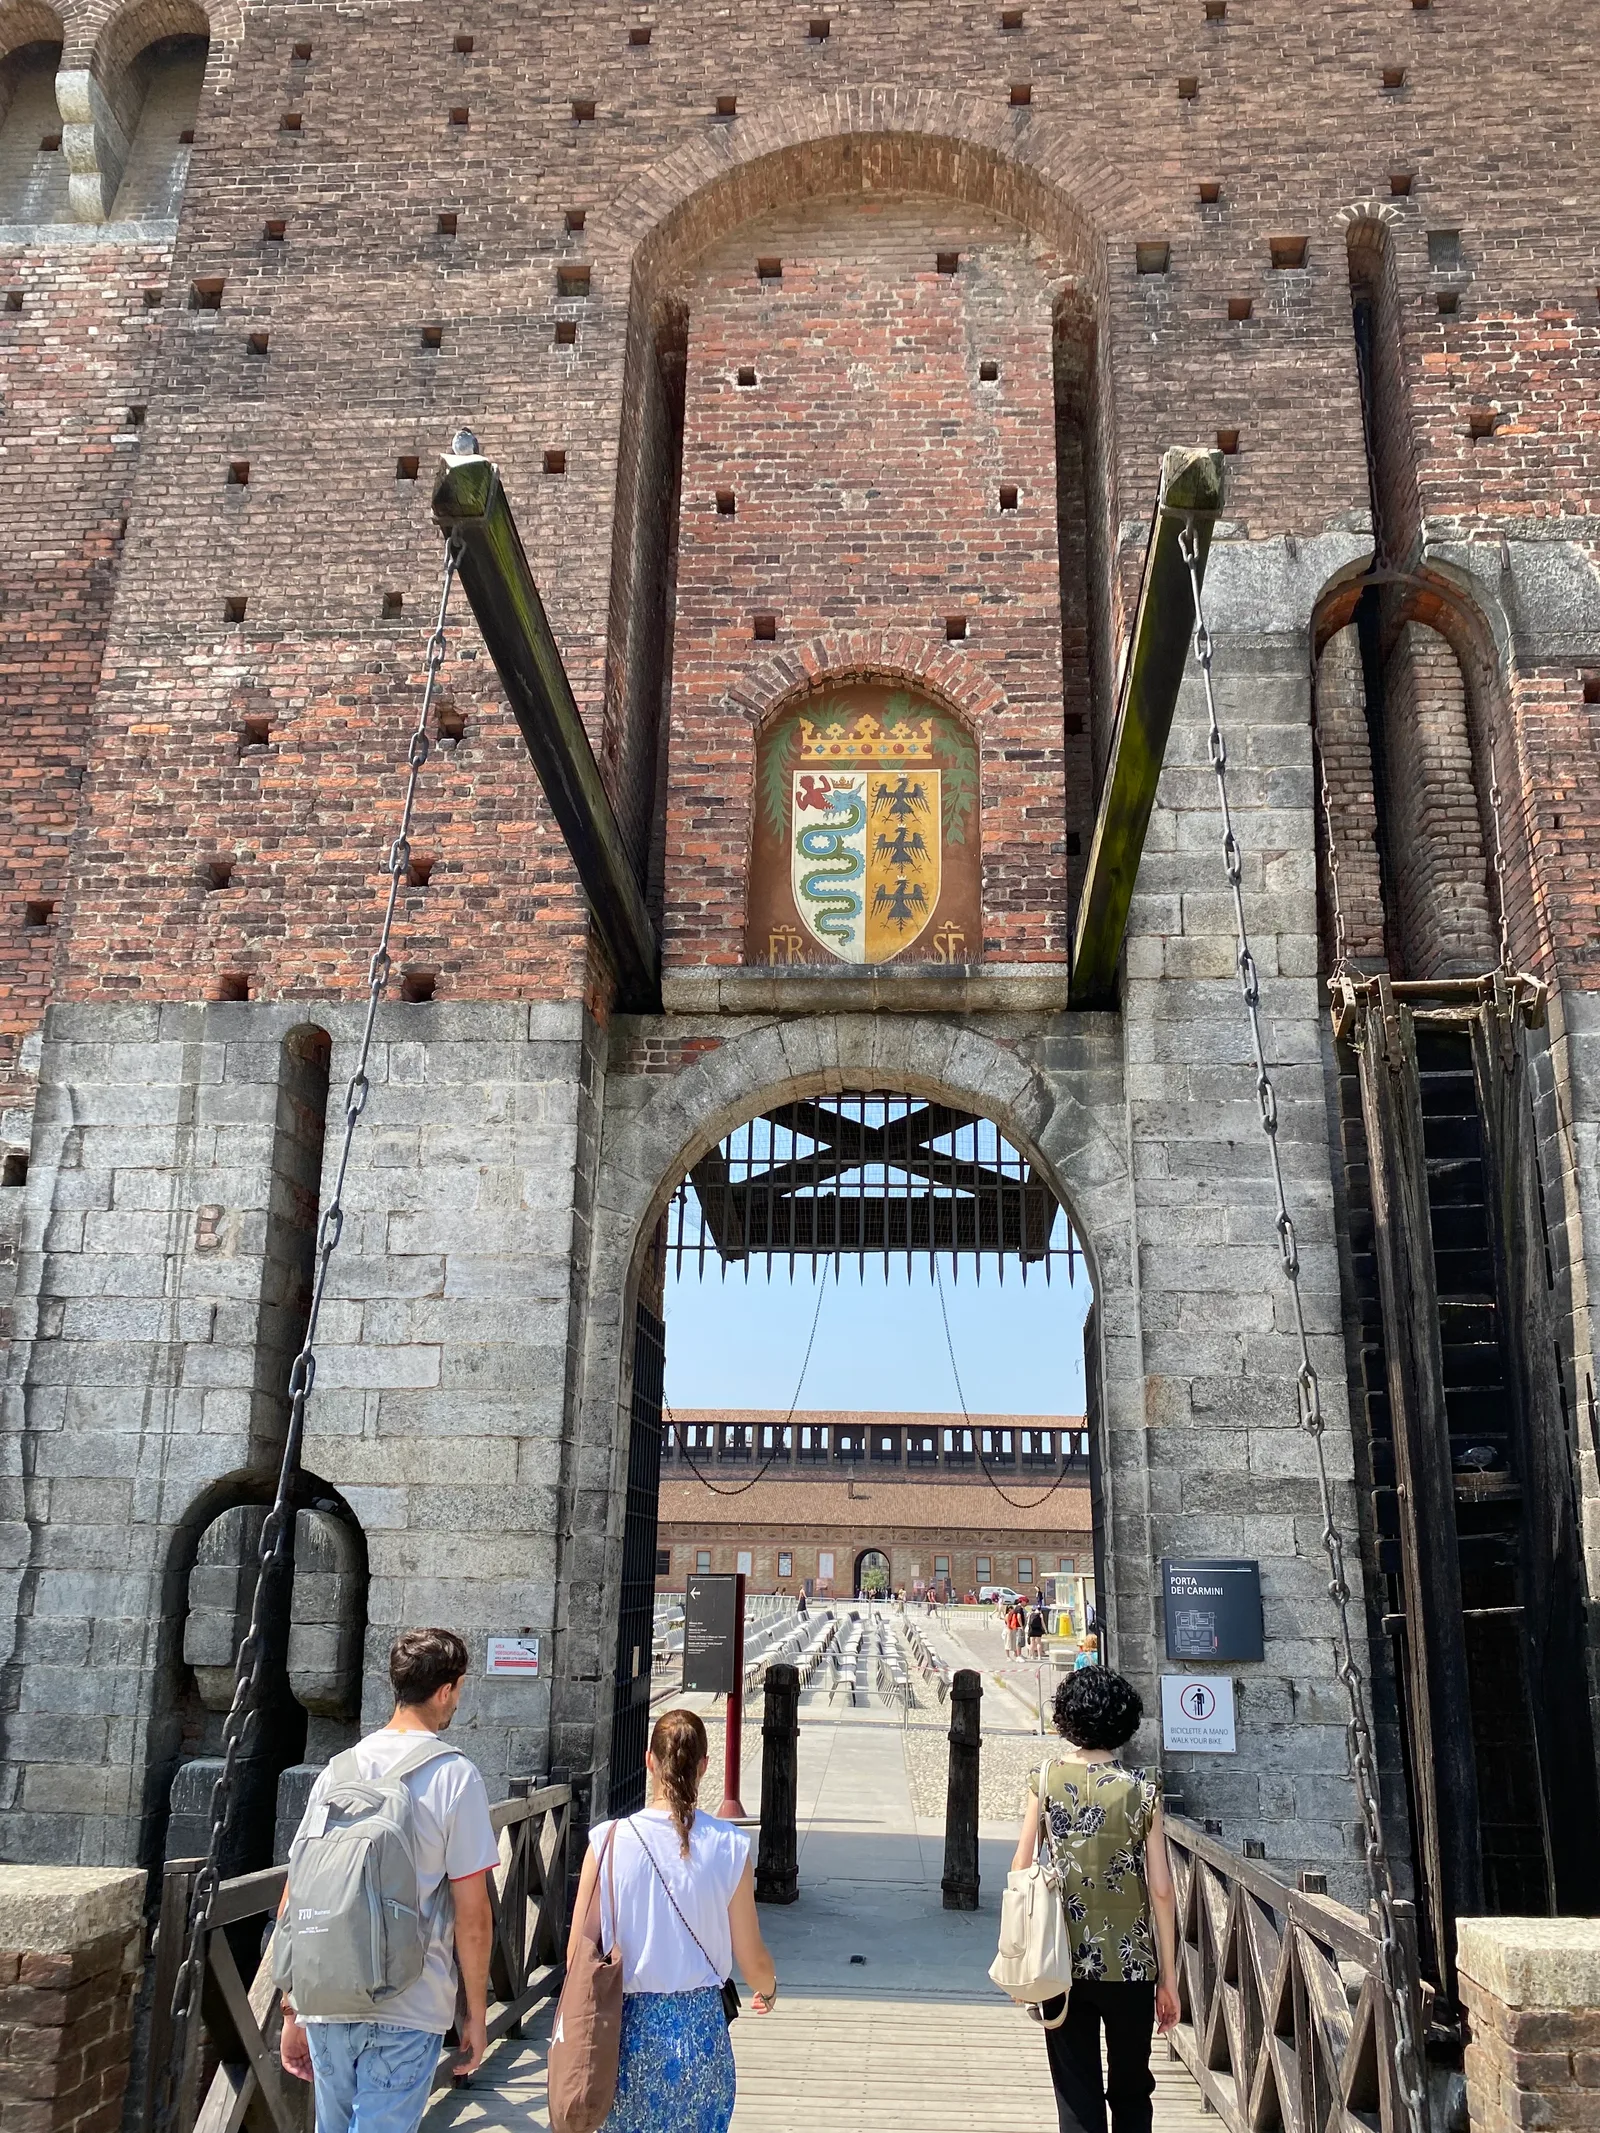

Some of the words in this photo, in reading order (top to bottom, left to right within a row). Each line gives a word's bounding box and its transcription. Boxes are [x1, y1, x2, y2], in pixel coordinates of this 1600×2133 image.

[769, 934, 806, 967] FR
[933, 934, 965, 965] SF
[1170, 1576, 1197, 1586] PORTA
[1171, 1586, 1184, 1595] DEI
[1187, 1587, 1224, 1596] CARMINI
[1170, 1727, 1201, 1735] BICICLETTE
